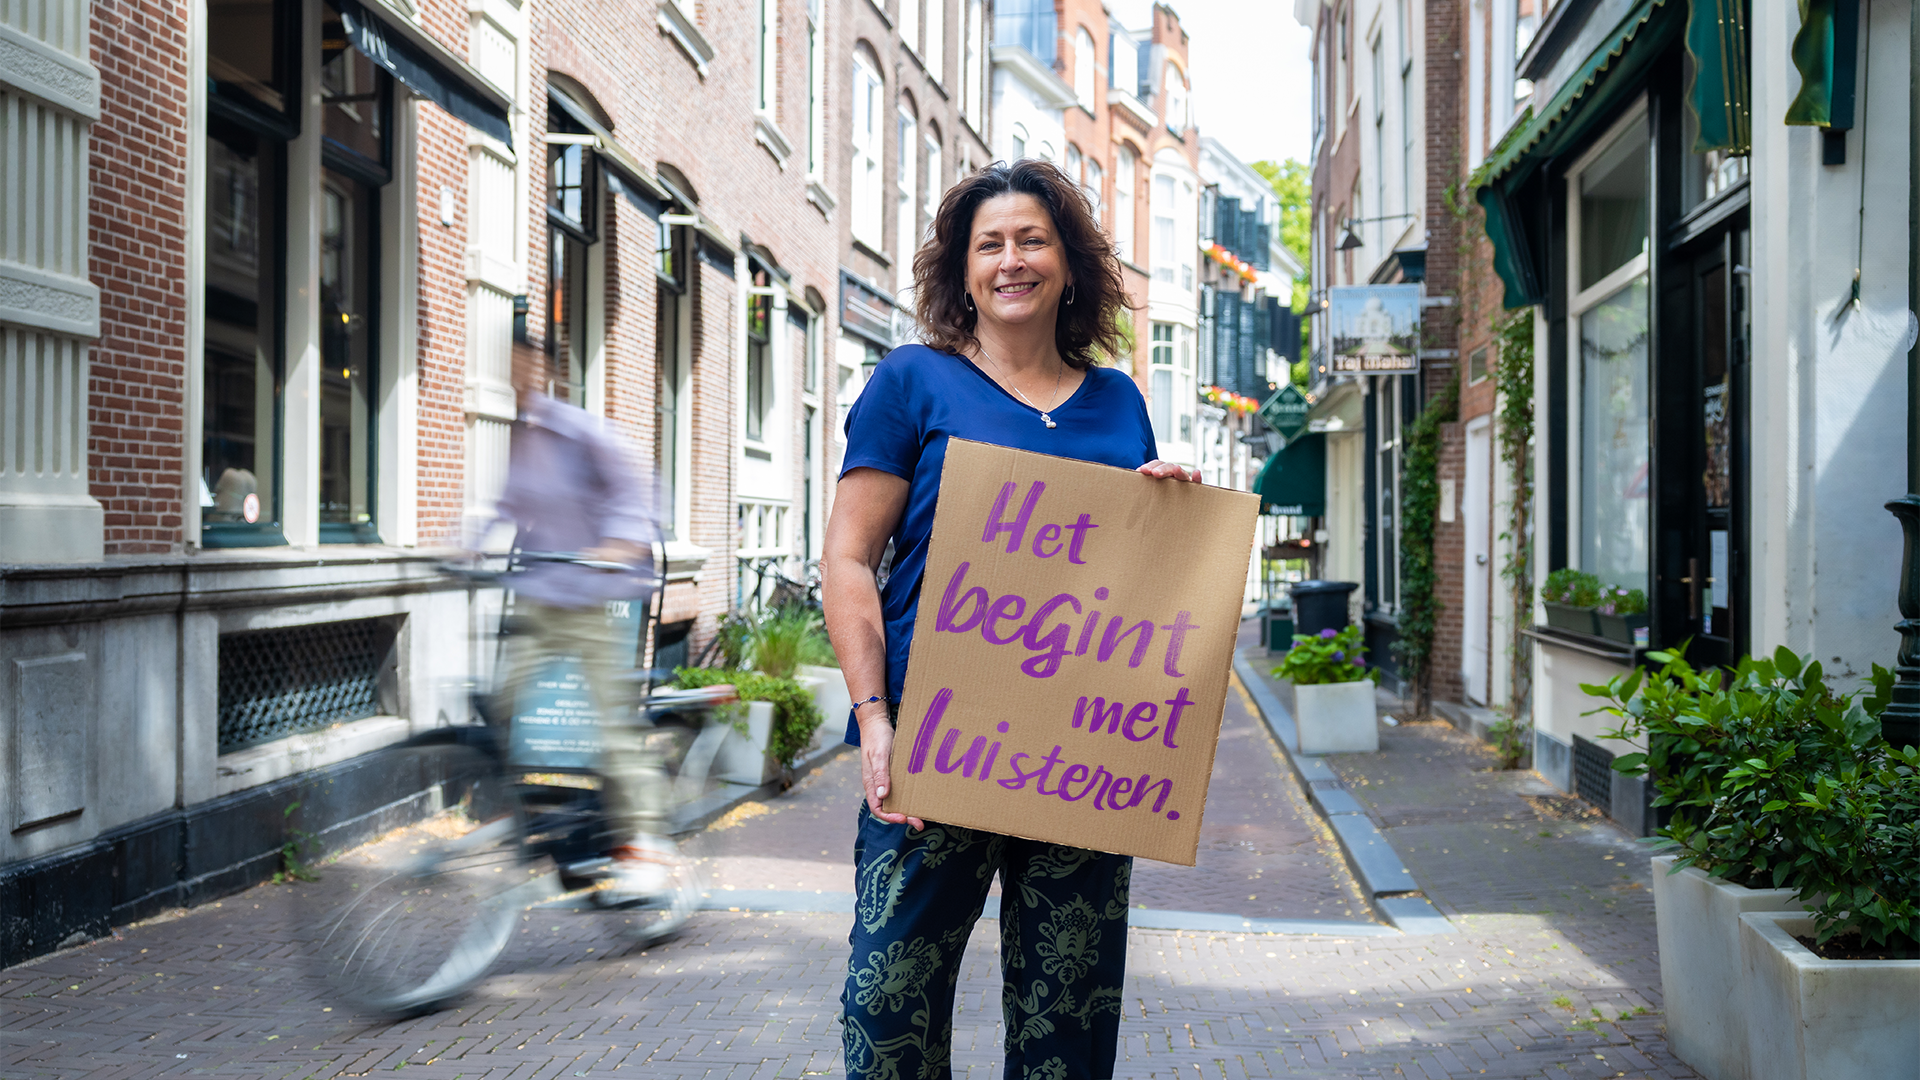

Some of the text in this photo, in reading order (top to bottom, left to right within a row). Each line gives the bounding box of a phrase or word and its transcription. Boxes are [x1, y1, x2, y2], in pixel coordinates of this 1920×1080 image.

[1334, 354, 1361, 372] Taj
[981, 480, 1099, 564] Het
[935, 561, 1200, 678] begint
[907, 687, 1181, 821] luisteren.
[1071, 686, 1195, 749] met
